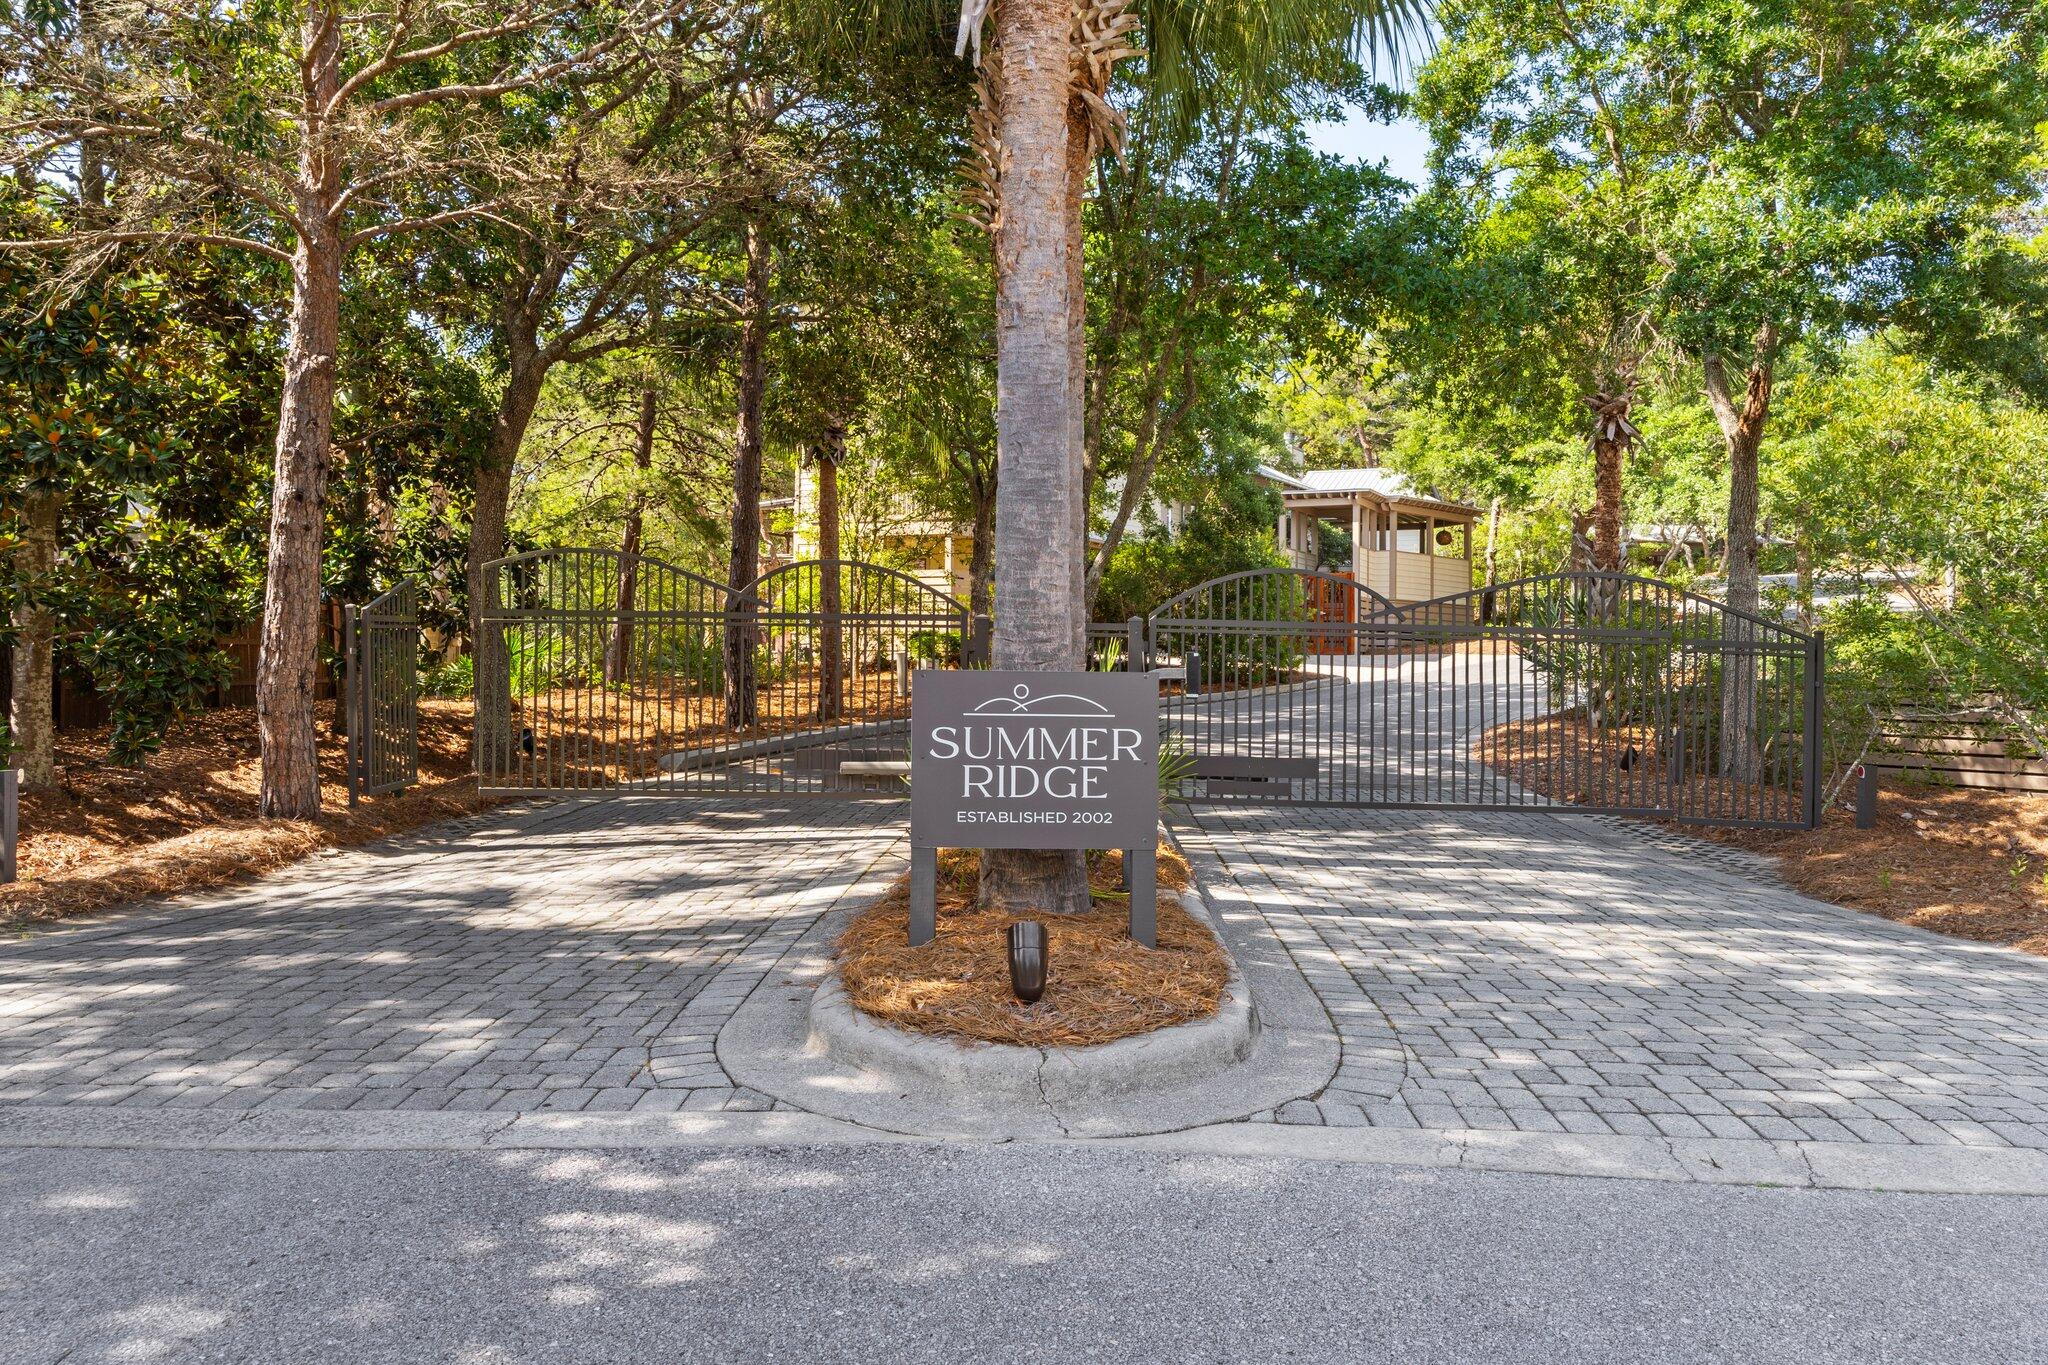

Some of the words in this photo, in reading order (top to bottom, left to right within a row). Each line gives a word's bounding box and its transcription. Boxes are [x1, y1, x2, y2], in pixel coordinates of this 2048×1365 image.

[929, 726, 1142, 761] SUMMER
[961, 764, 1108, 799] RIDGE
[957, 811, 1067, 824] ESTABLISHED
[1072, 812, 1113, 824] 2002
